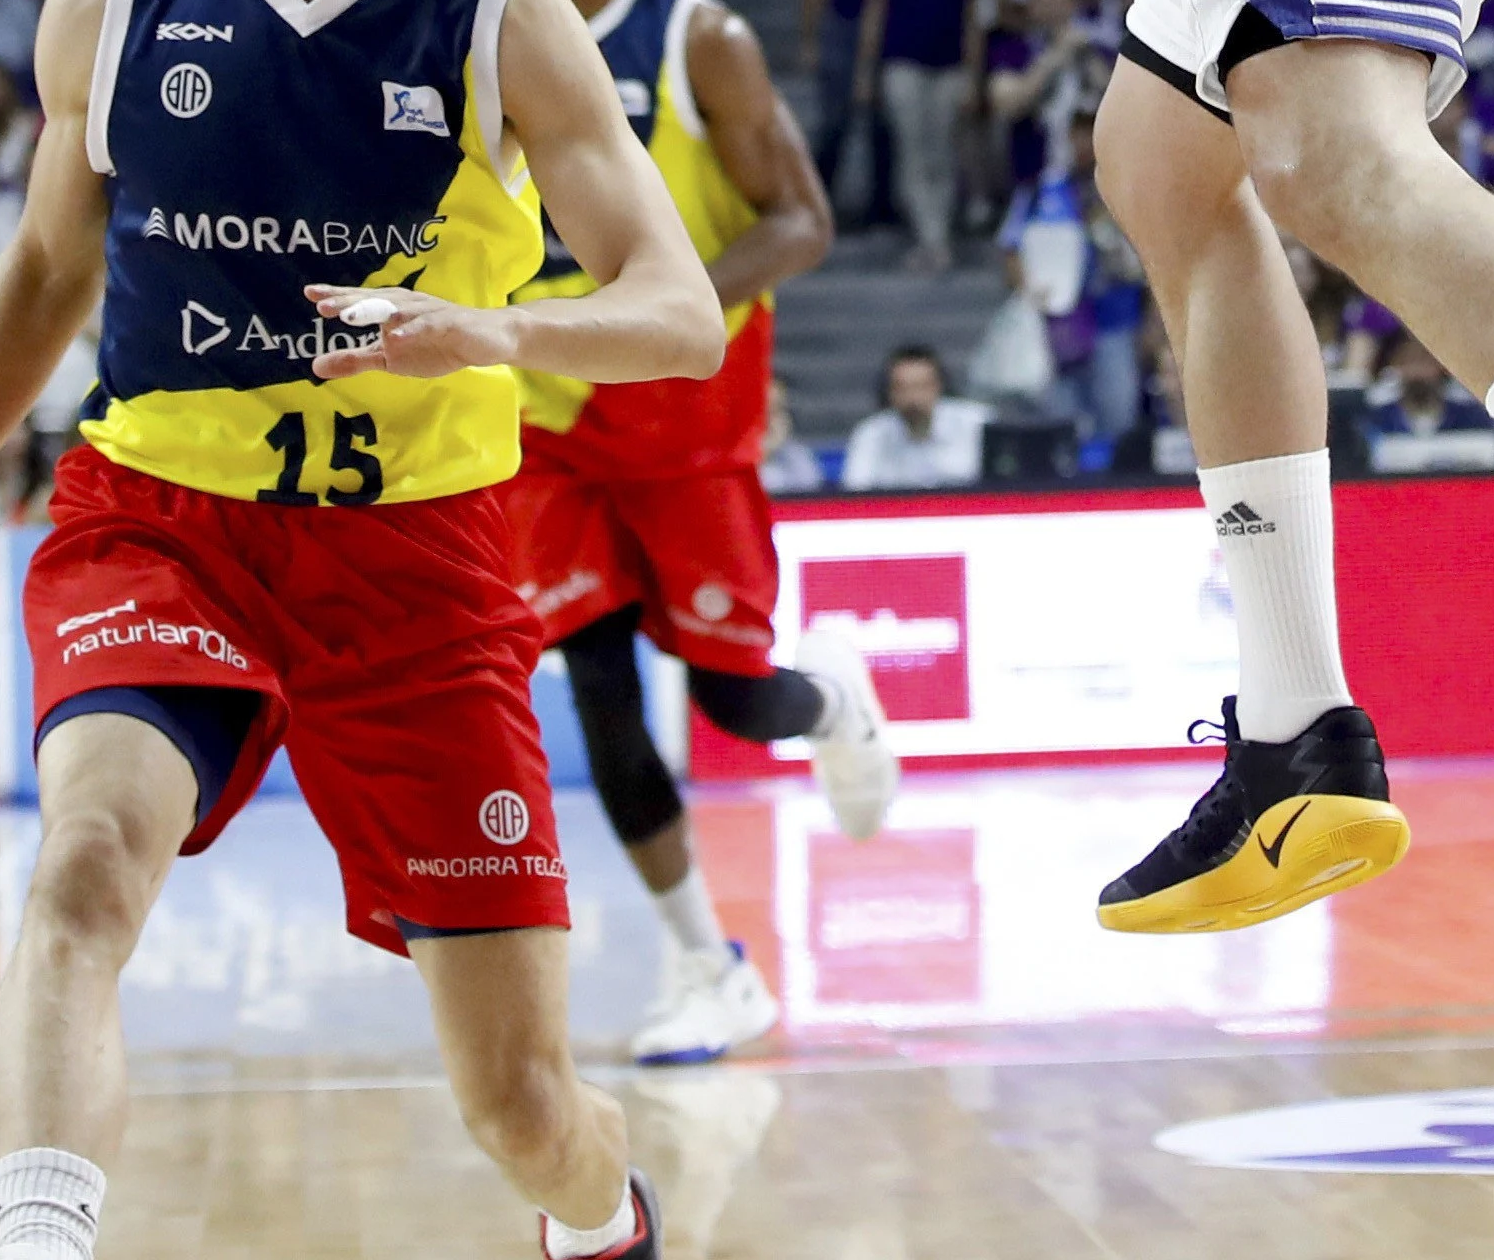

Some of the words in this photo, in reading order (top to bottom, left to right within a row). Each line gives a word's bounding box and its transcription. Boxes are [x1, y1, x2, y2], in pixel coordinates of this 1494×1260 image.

[174, 212, 447, 257] MORABANC
[257, 410, 384, 506] 15
[63, 617, 249, 672] naturlandia
[407, 855, 519, 878] ANDORRA
